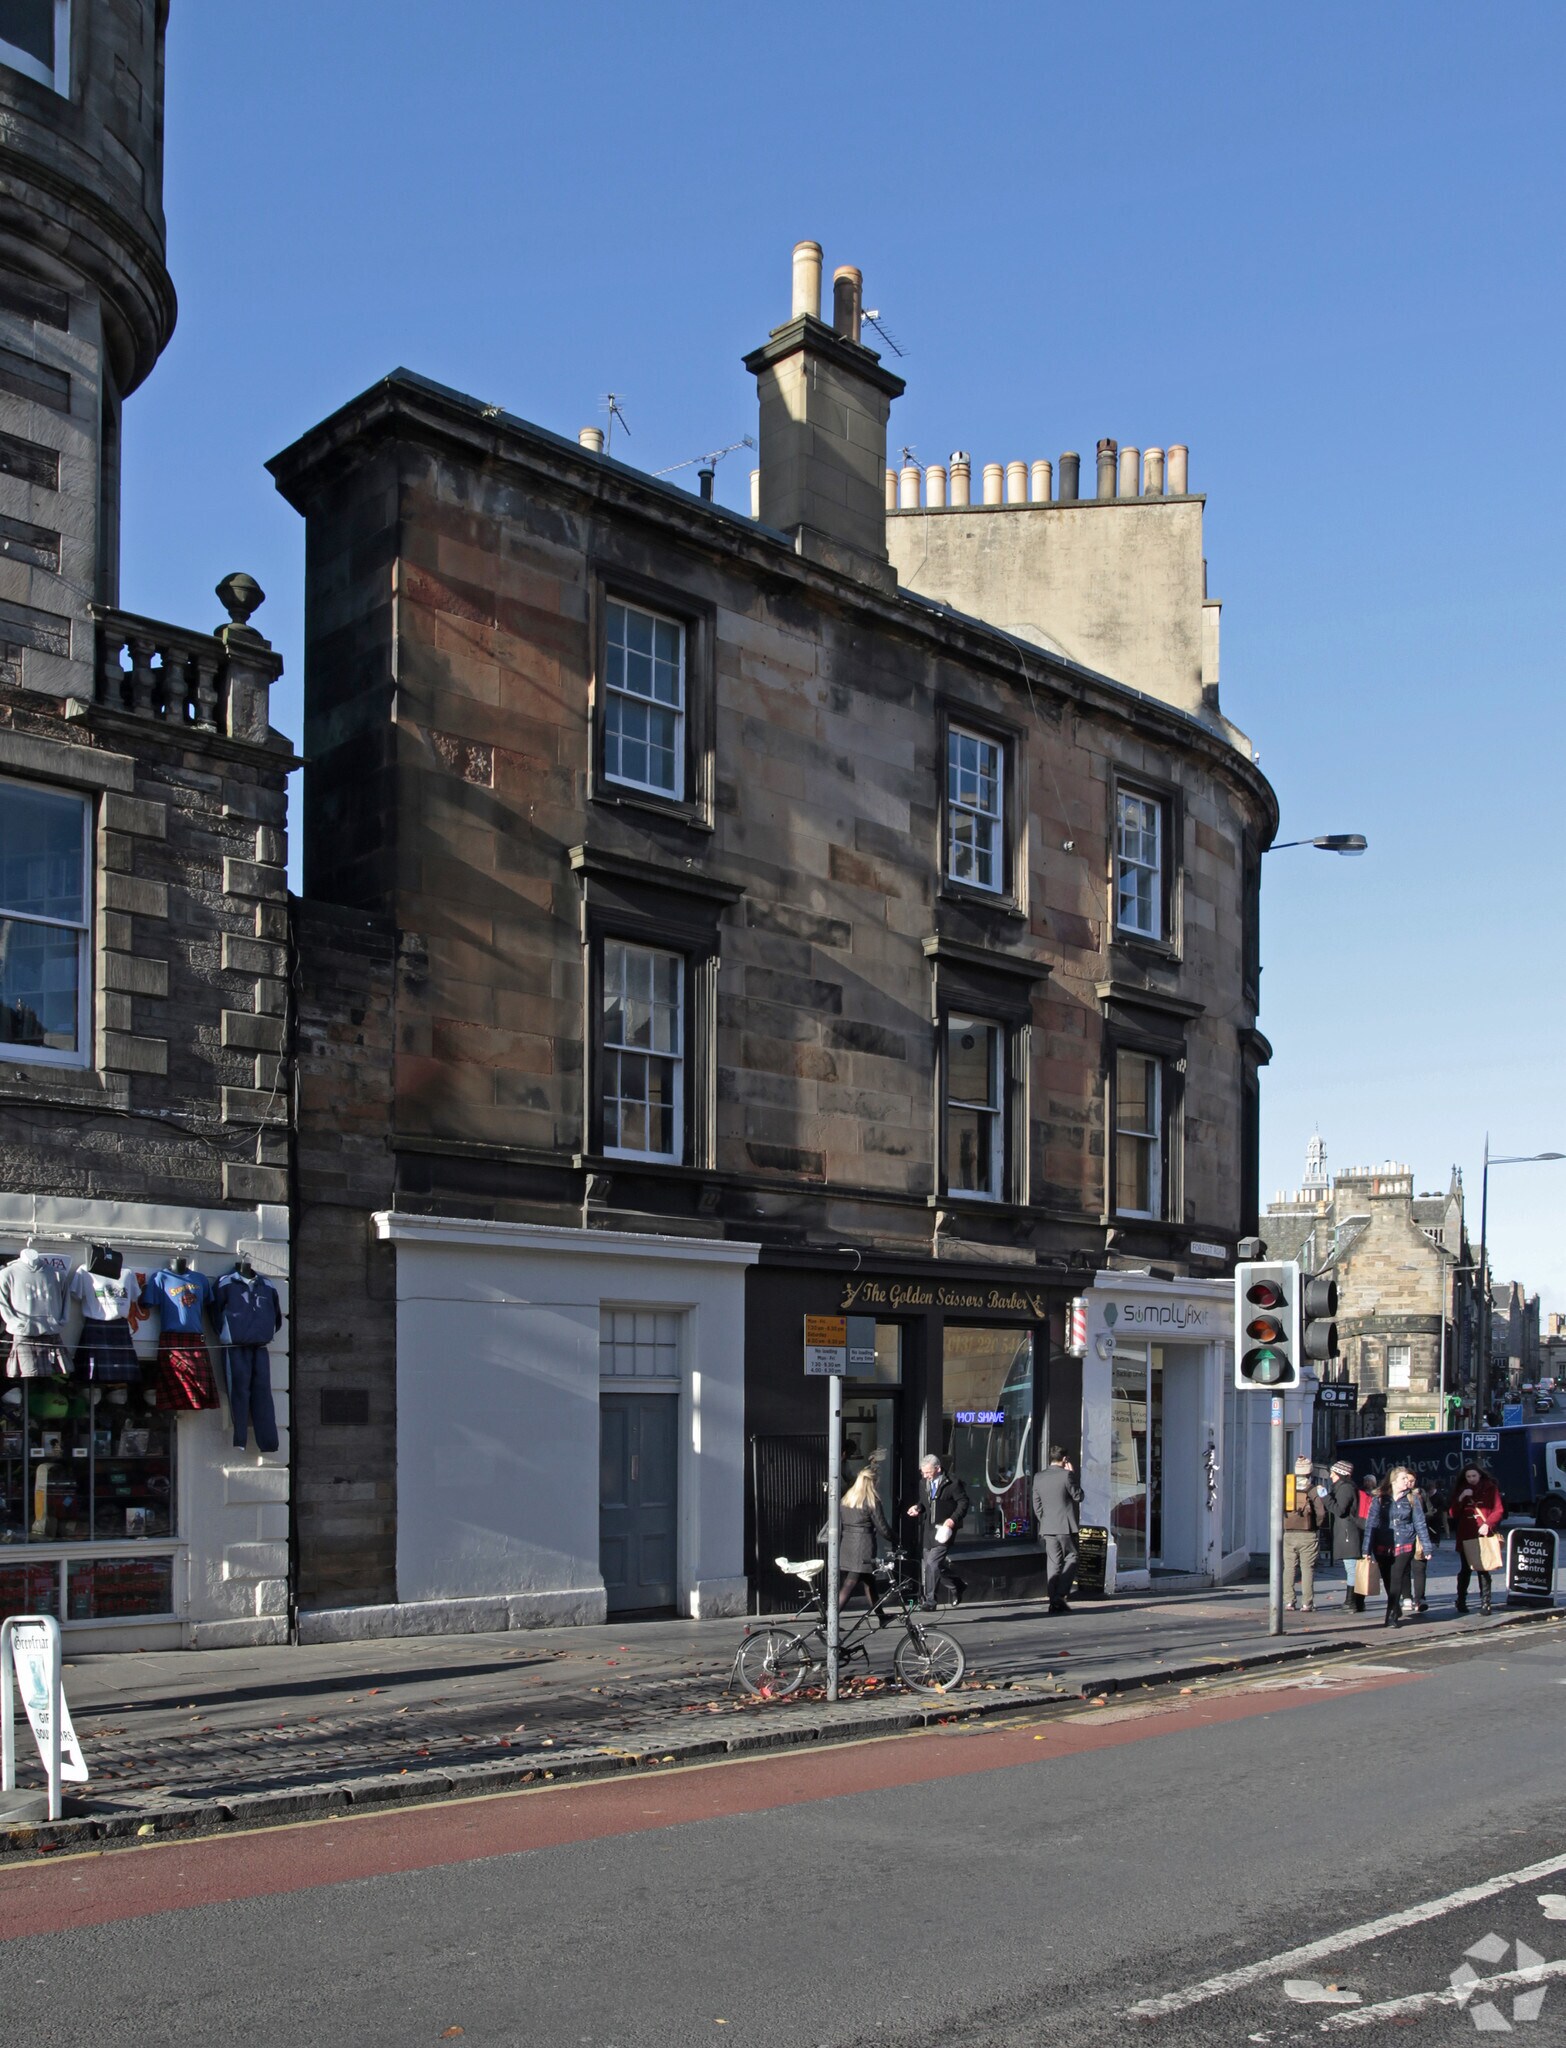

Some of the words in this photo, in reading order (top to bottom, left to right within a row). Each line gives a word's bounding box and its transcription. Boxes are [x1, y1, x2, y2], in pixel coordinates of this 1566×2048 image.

[861, 1282, 886, 1303] The
[889, 1284, 933, 1309] Golden
[936, 1287, 983, 1308] Scissors
[987, 1290, 1028, 1310] Barber
[956, 1411, 976, 1423] HOT
[977, 1411, 1005, 1424] SHAVE
[1370, 1455, 1440, 1475] Matthew
[1445, 1451, 1494, 1471] Clak
[1523, 1538, 1544, 1547] Your
[1517, 1546, 1549, 1557] LOCAL
[1518, 1554, 1546, 1565] Repair
[1517, 1563, 1546, 1573] Centre
